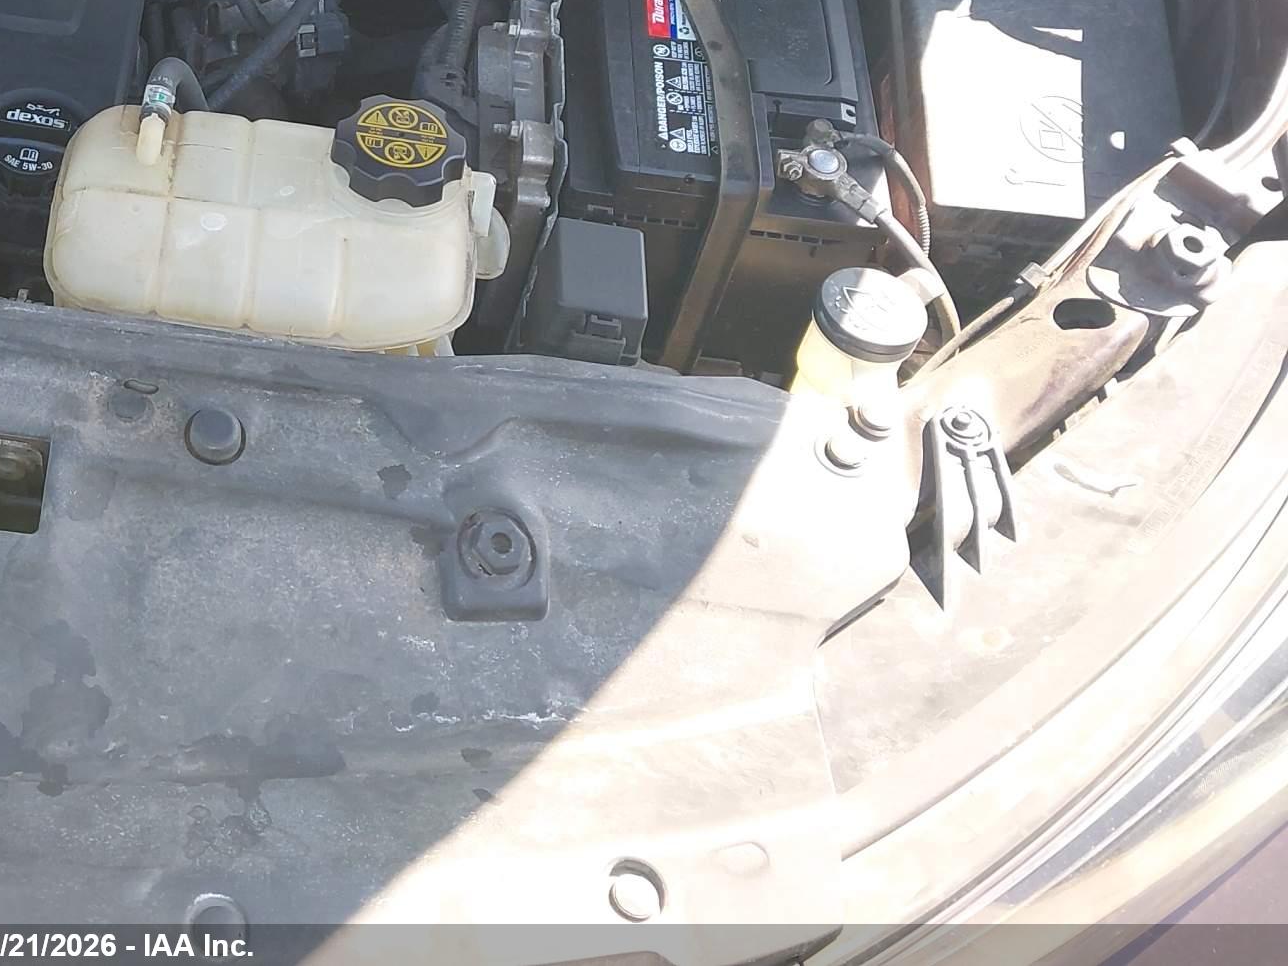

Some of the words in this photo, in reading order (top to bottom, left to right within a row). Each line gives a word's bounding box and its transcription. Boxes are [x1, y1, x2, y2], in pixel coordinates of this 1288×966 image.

[654, 61, 668, 132] DANGER/POISON
[6, 109, 66, 129] dexos
[4, 154, 21, 168] SAE
[22, 161, 53, 171] 5W-30
